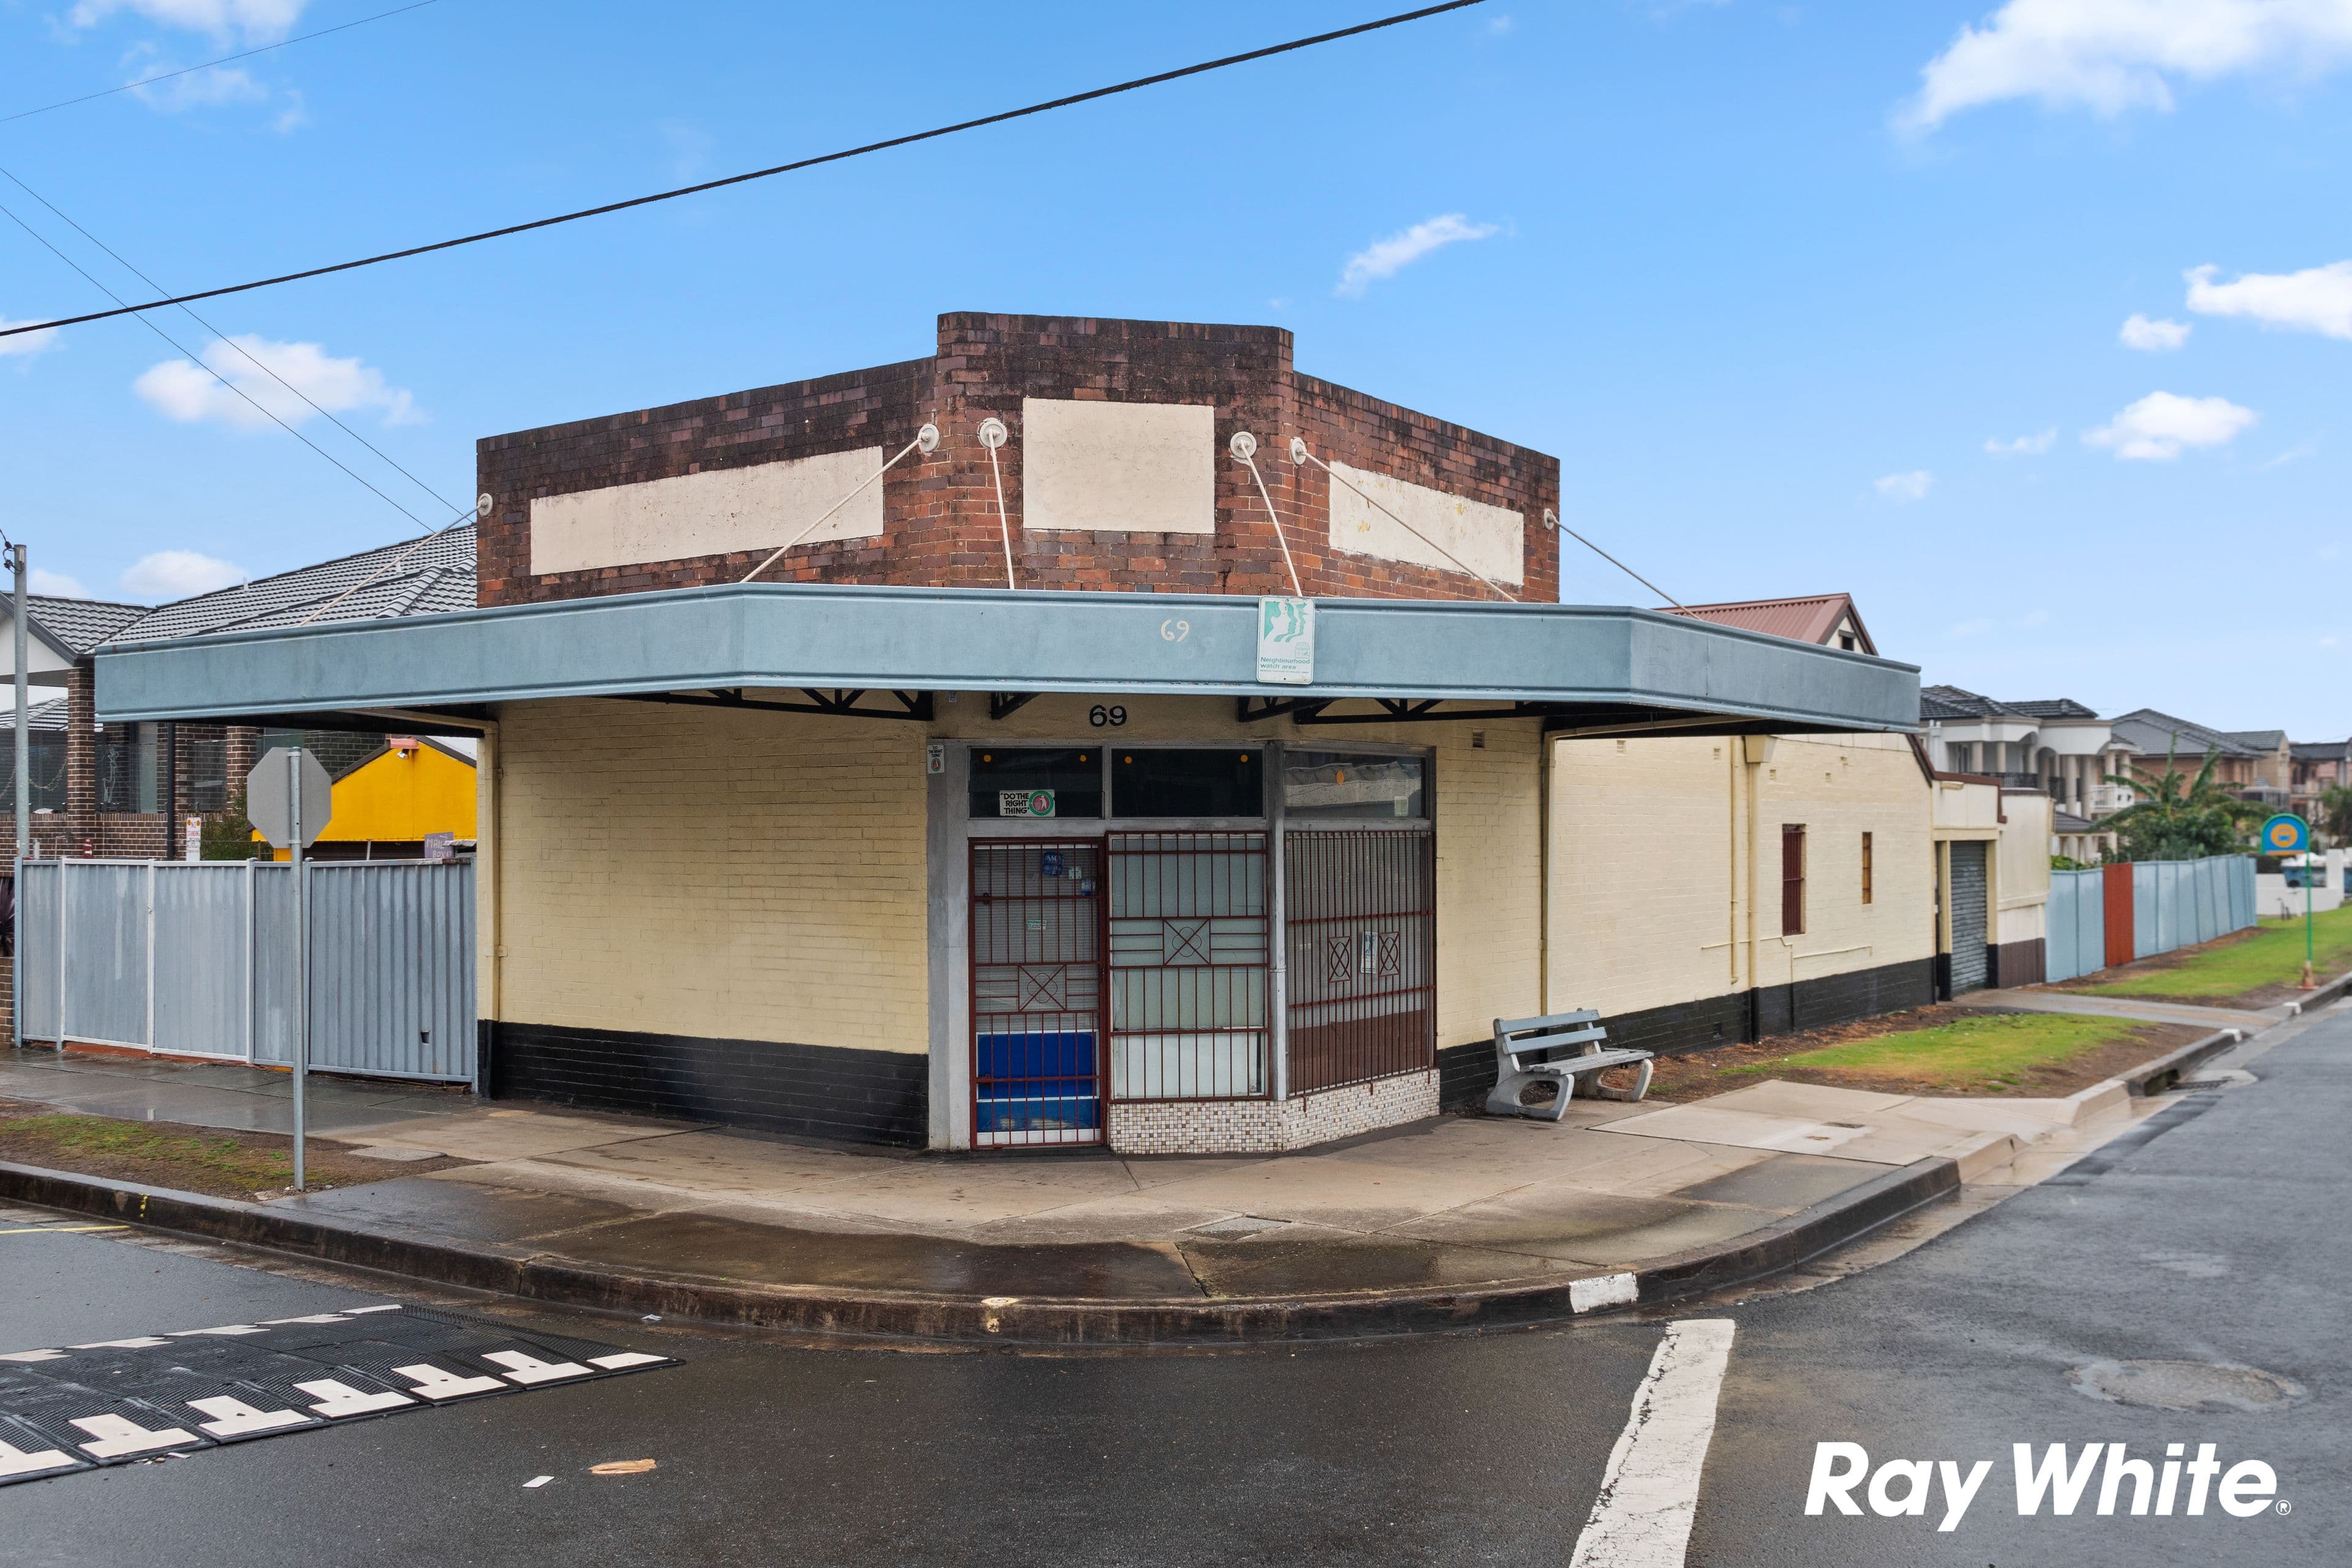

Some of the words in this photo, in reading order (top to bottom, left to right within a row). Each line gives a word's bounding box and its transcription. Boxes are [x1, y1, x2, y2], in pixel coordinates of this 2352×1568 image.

[1161, 619, 1189, 642] 69
[1090, 704, 1127, 727] 69
[426, 839, 445, 849] MAIL
